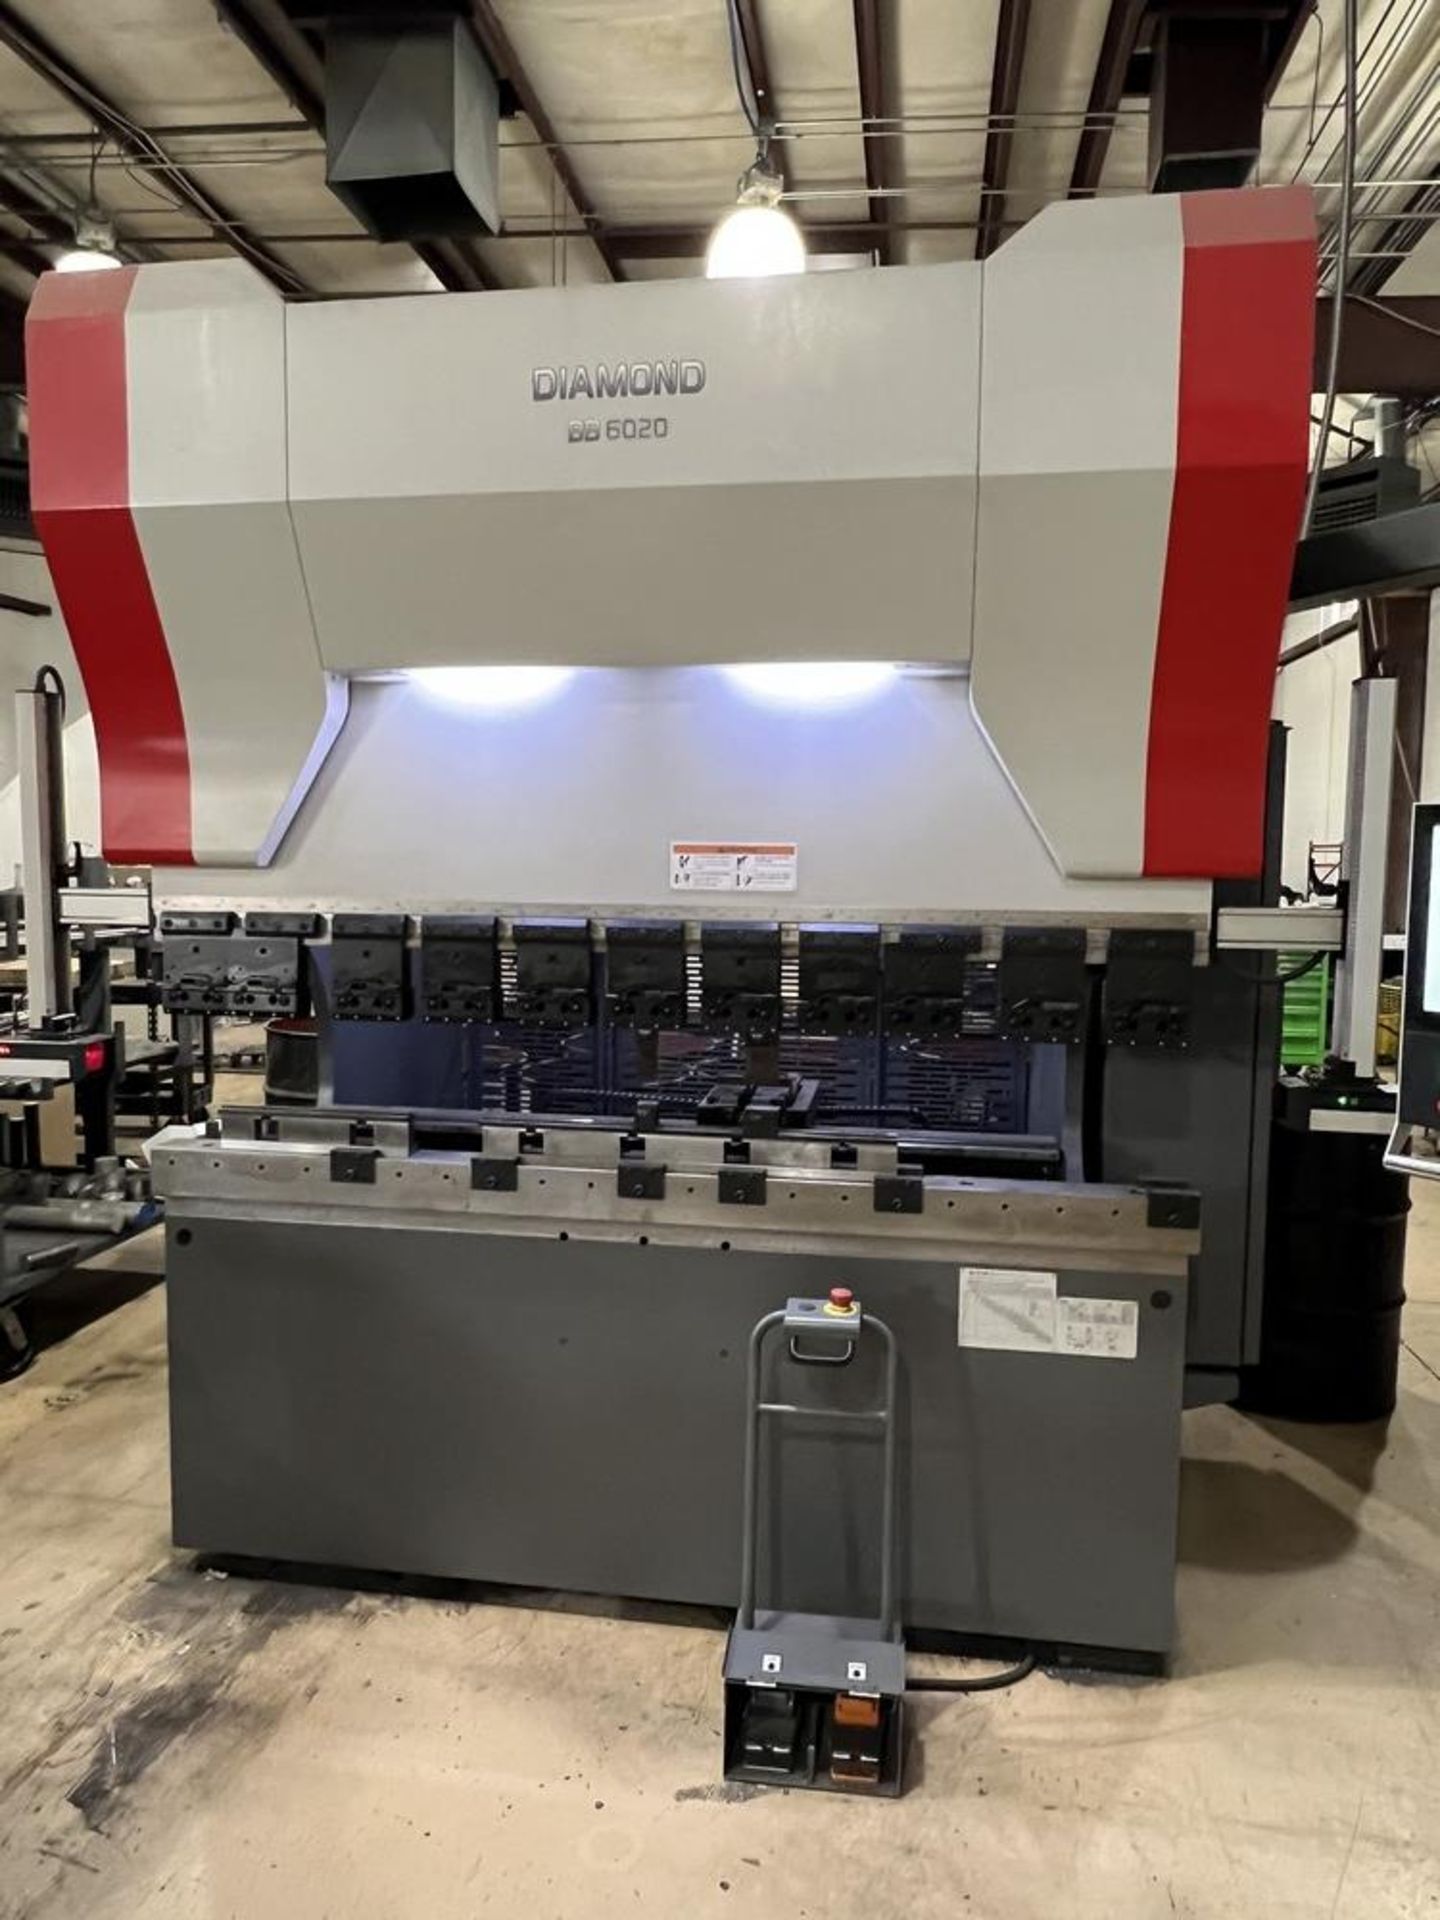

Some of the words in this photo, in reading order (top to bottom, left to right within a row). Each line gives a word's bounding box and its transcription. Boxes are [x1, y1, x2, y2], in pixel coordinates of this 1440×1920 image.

[532, 359, 706, 401] DIAMOND
[568, 419, 600, 443] BB
[606, 417, 668, 440] 6020
